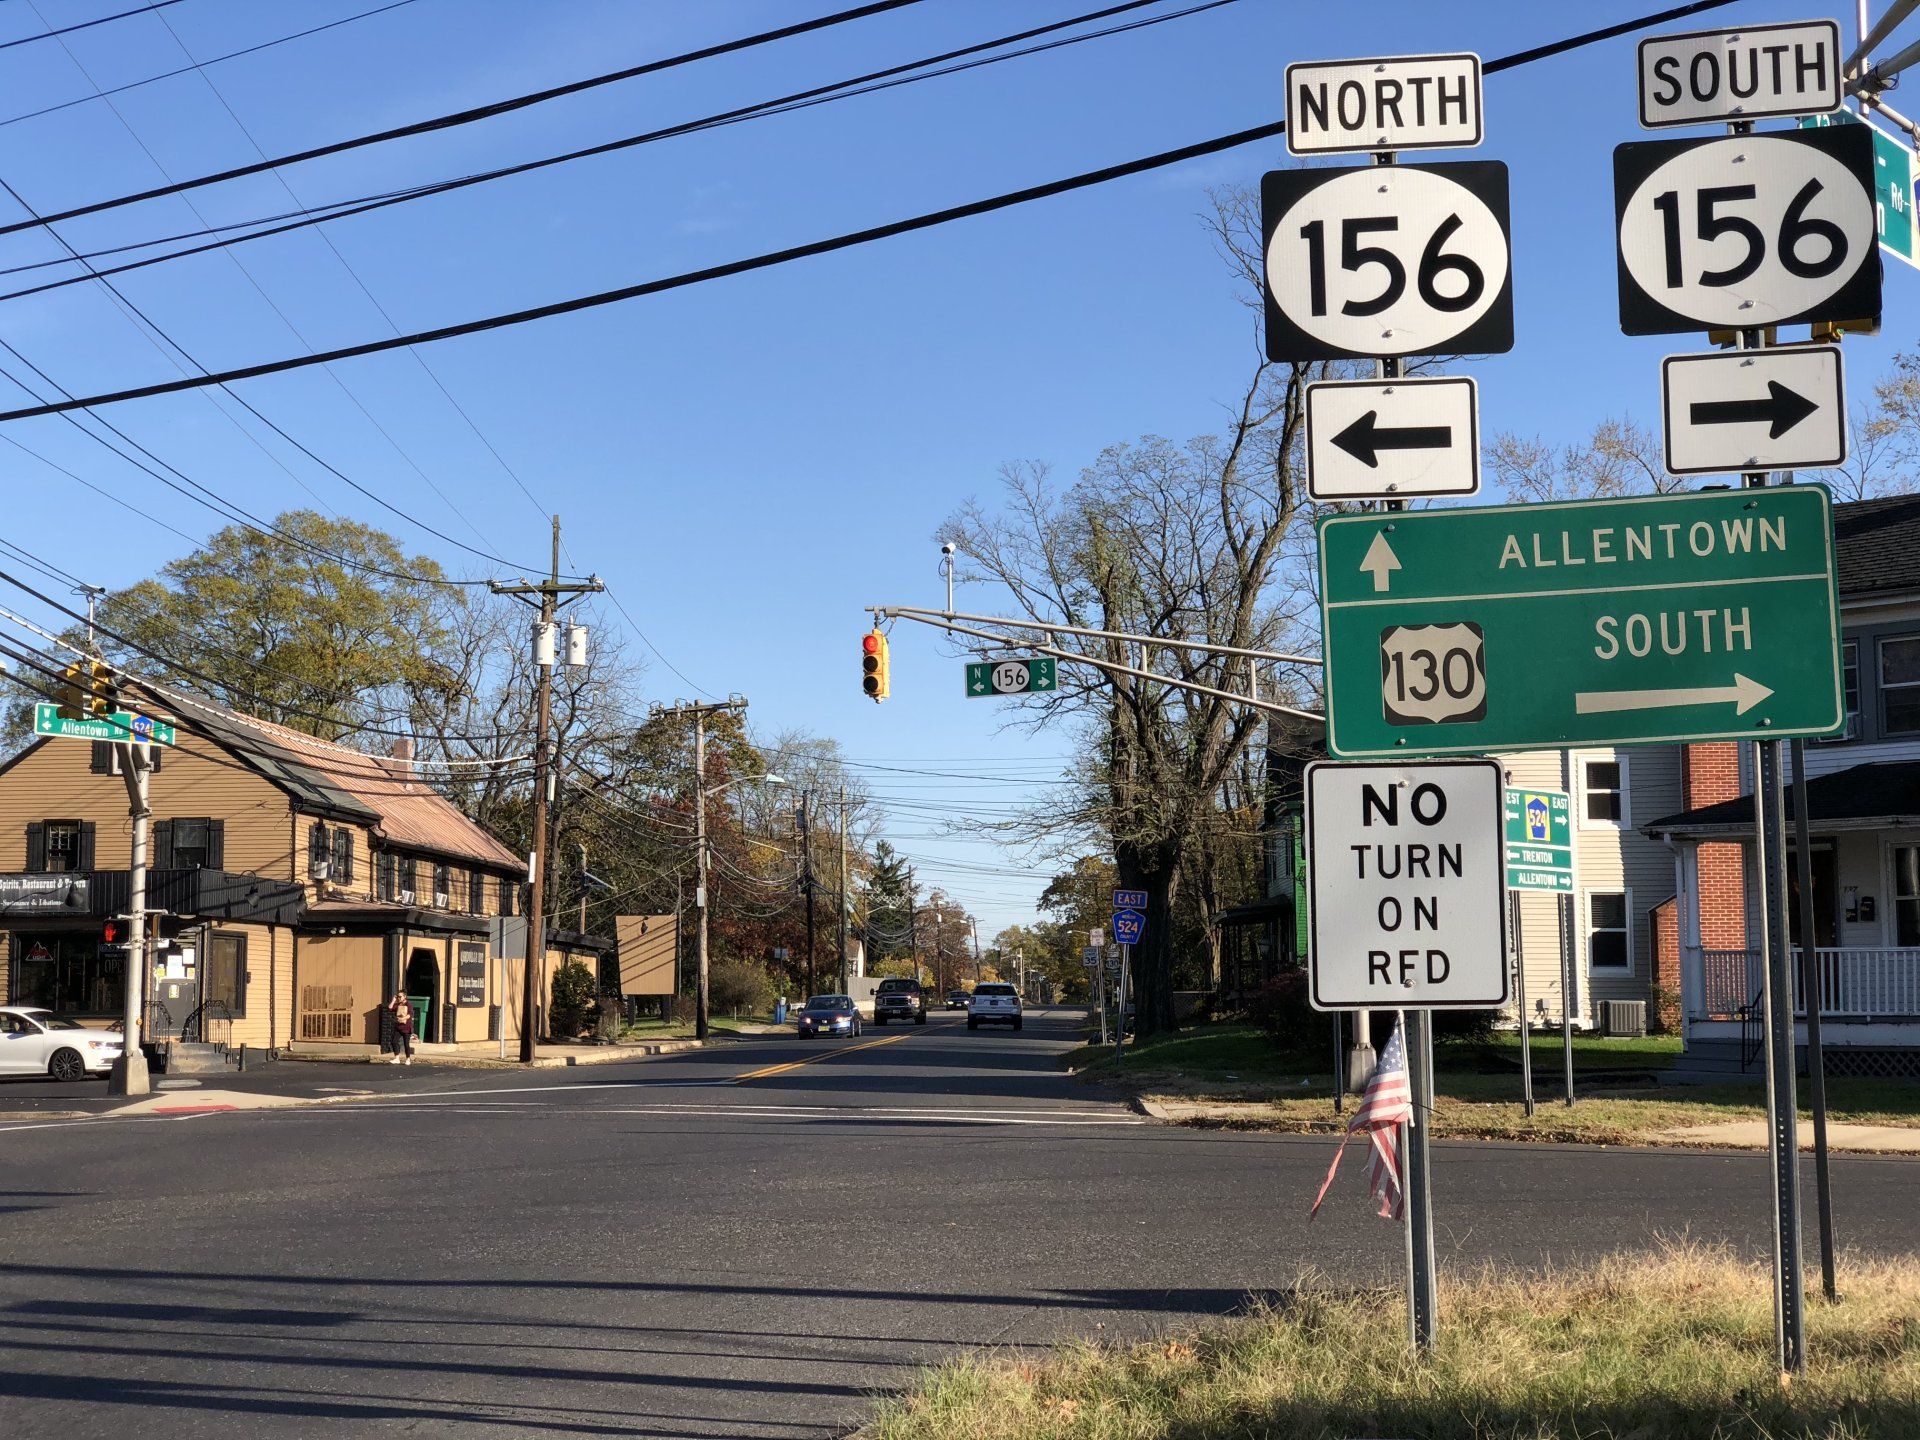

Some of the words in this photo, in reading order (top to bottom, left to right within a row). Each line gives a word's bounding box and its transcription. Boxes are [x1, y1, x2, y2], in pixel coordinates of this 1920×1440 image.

[1653, 42, 1826, 106] SOUTH
[1300, 76, 1467, 132] NORTH
[1891, 181, 1903, 213] Rd
[1654, 178, 1848, 288] 156
[1300, 213, 1484, 316] 156
[1499, 517, 1786, 569] ALLENTOWN
[1595, 607, 1752, 659] SOUTH
[974, 667, 981, 679] N
[996, 668, 1026, 687] 156
[1040, 662, 1048, 674] S
[1392, 648, 1474, 702] 130
[43, 707, 51, 719] W
[61, 722, 109, 737] Allentown
[134, 721, 150, 735] 524
[1363, 783, 1447, 826] NO
[1506, 792, 1520, 805] EST
[1552, 796, 1568, 810] EAST
[1529, 808, 1546, 827] 524
[1351, 844, 1462, 880] TURN
[1522, 850, 1553, 864] TRENTON
[1518, 872, 1558, 886] ALLENTOWN
[1118, 893, 1142, 905] EAST
[1378, 897, 1437, 931] ON
[1118, 921, 1138, 933] 524
[1084, 956, 1097, 965] 35
